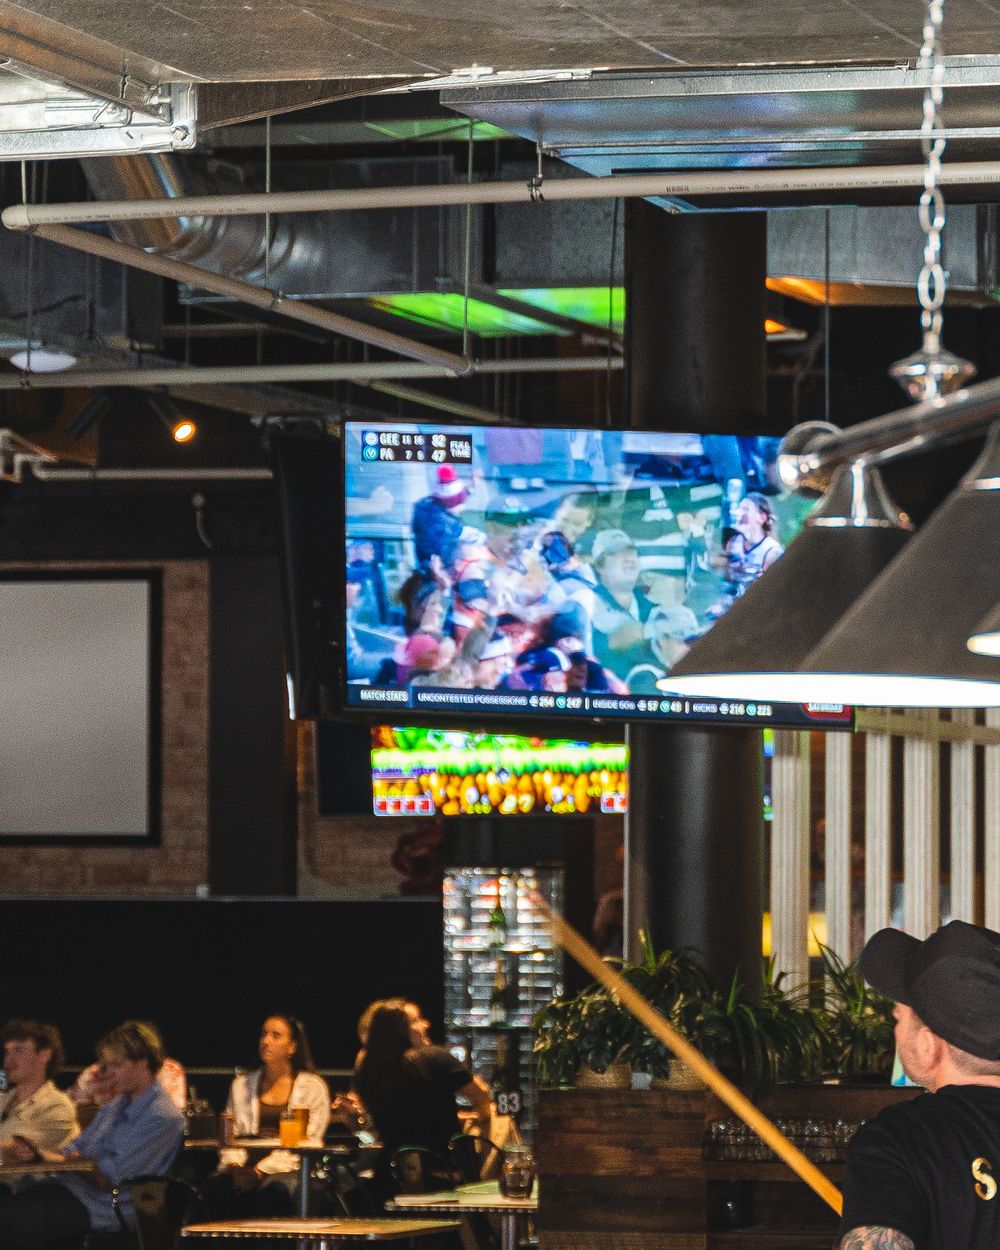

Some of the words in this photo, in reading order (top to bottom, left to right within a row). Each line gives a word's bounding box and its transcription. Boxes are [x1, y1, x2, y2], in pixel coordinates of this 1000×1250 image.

[450, 441, 470, 450] FULL
[380, 447, 395, 461] PA
[431, 449, 447, 463] 47
[451, 449, 471, 458] TIME
[360, 689, 385, 701] MATCH
[386, 690, 409, 702] STATS
[417, 692, 473, 704] UNCONTESTED
[474, 694, 528, 706] POSSESSIONS
[592, 699, 618, 709] INSIDE
[498, 1093, 520, 1114] 83
